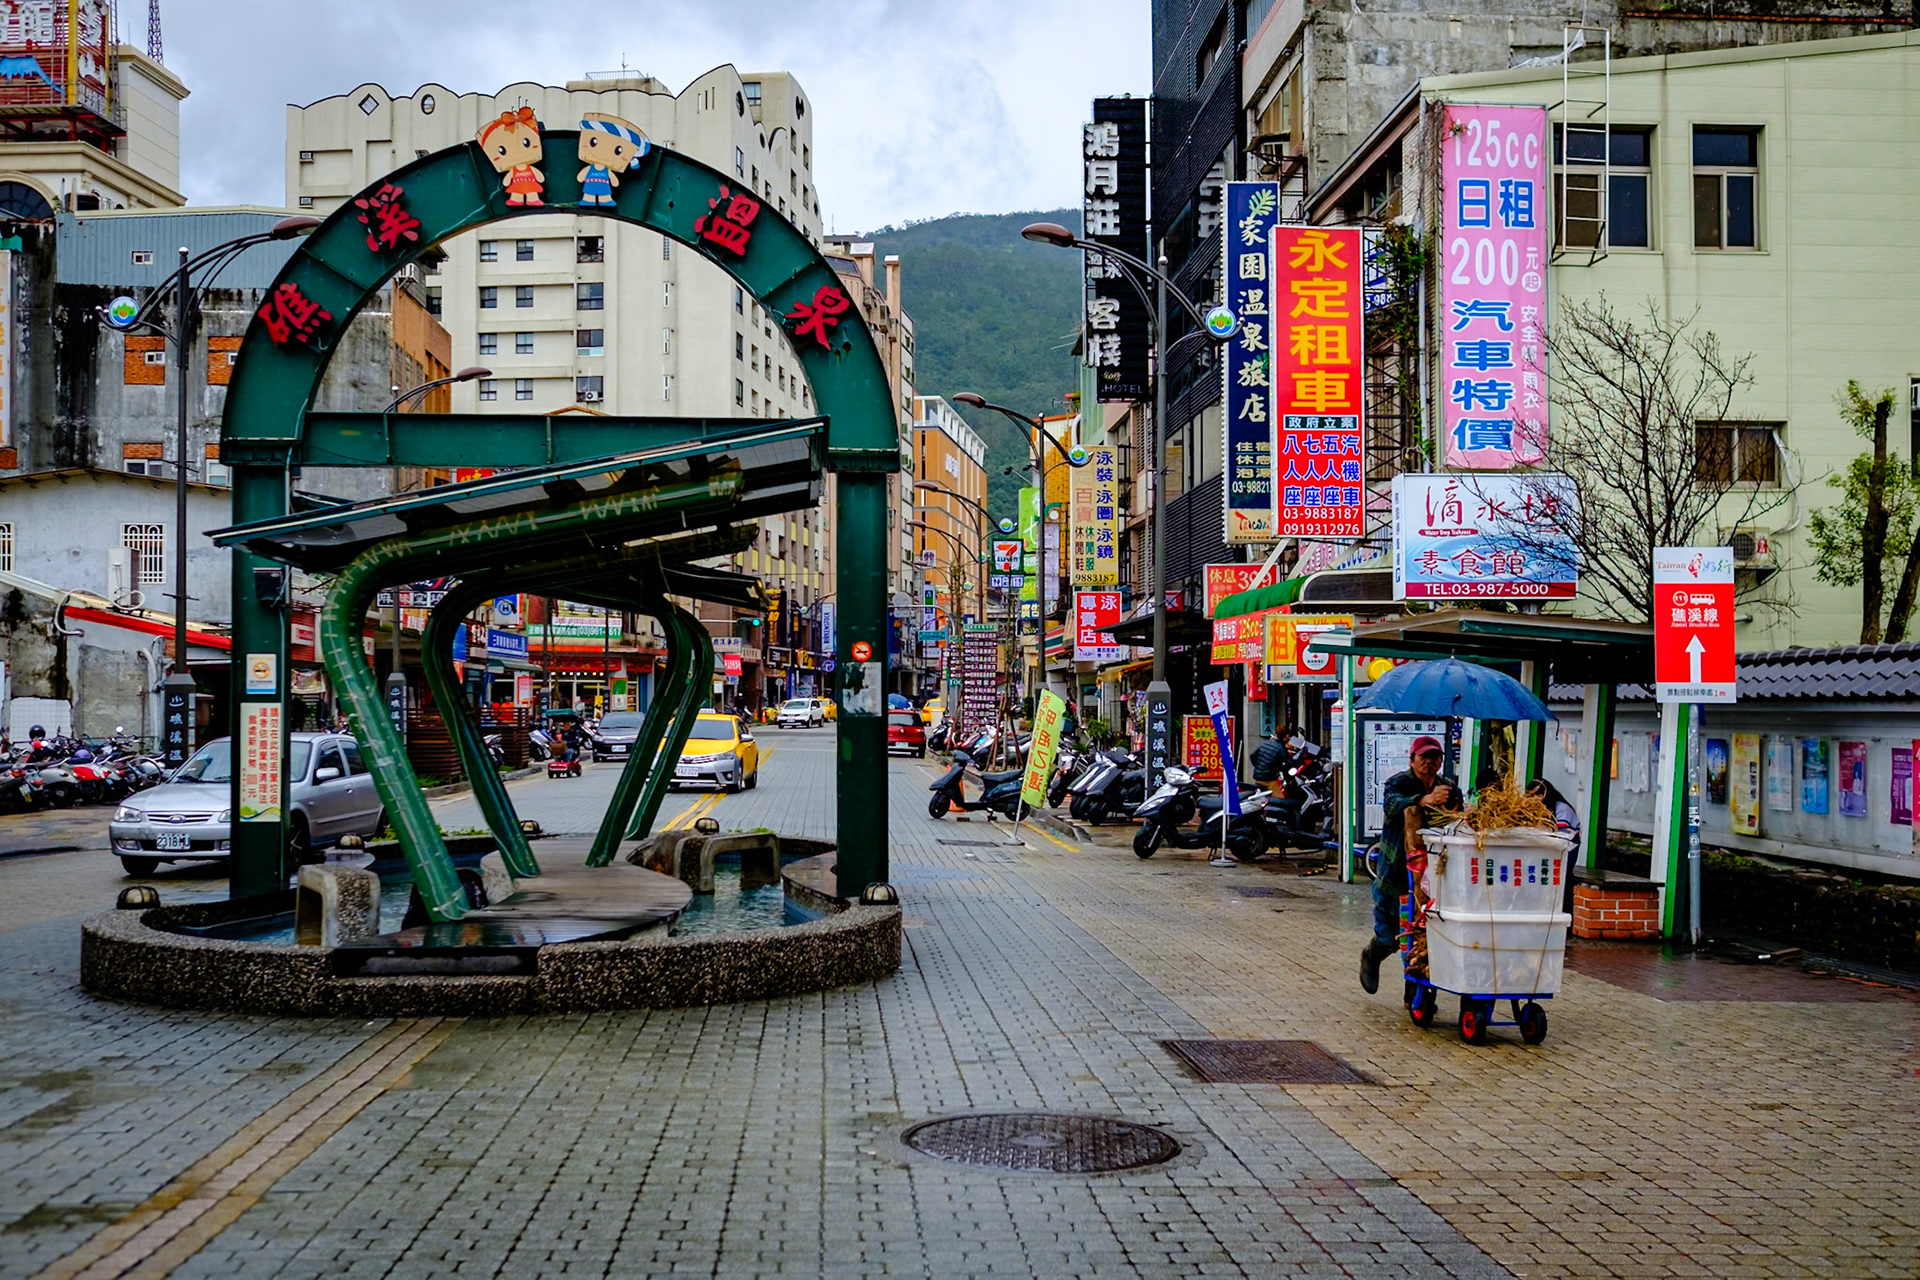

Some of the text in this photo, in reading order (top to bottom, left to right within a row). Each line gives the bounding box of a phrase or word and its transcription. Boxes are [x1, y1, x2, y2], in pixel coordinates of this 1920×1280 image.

[1454, 117, 1539, 170] 125cc
[1085, 121, 1120, 236] 鴻月莊
[1457, 177, 1537, 229] 日租
[1450, 237, 1520, 286] 200
[1289, 230, 1352, 412] 永定租車
[1450, 299, 1516, 452] 汽車特價
[1288, 417, 1359, 430] 政府立案
[1232, 481, 1271, 493] 03-98821
[1283, 508, 1360, 521] 03-9883187
[1283, 522, 1360, 536] 0919312976
[1414, 549, 1527, 576] 素食館
[1656, 561, 1687, 569] Taiwan
[1075, 574, 1115, 582] 9883187
[1209, 568, 1237, 583] 休息
[1425, 584, 1549, 595] TEL:03-987-5000
[1080, 595, 1097, 643] 專賣店
[1671, 608, 1718, 622] 礁溪線
[1373, 723, 1437, 732] 礁溪火車站
